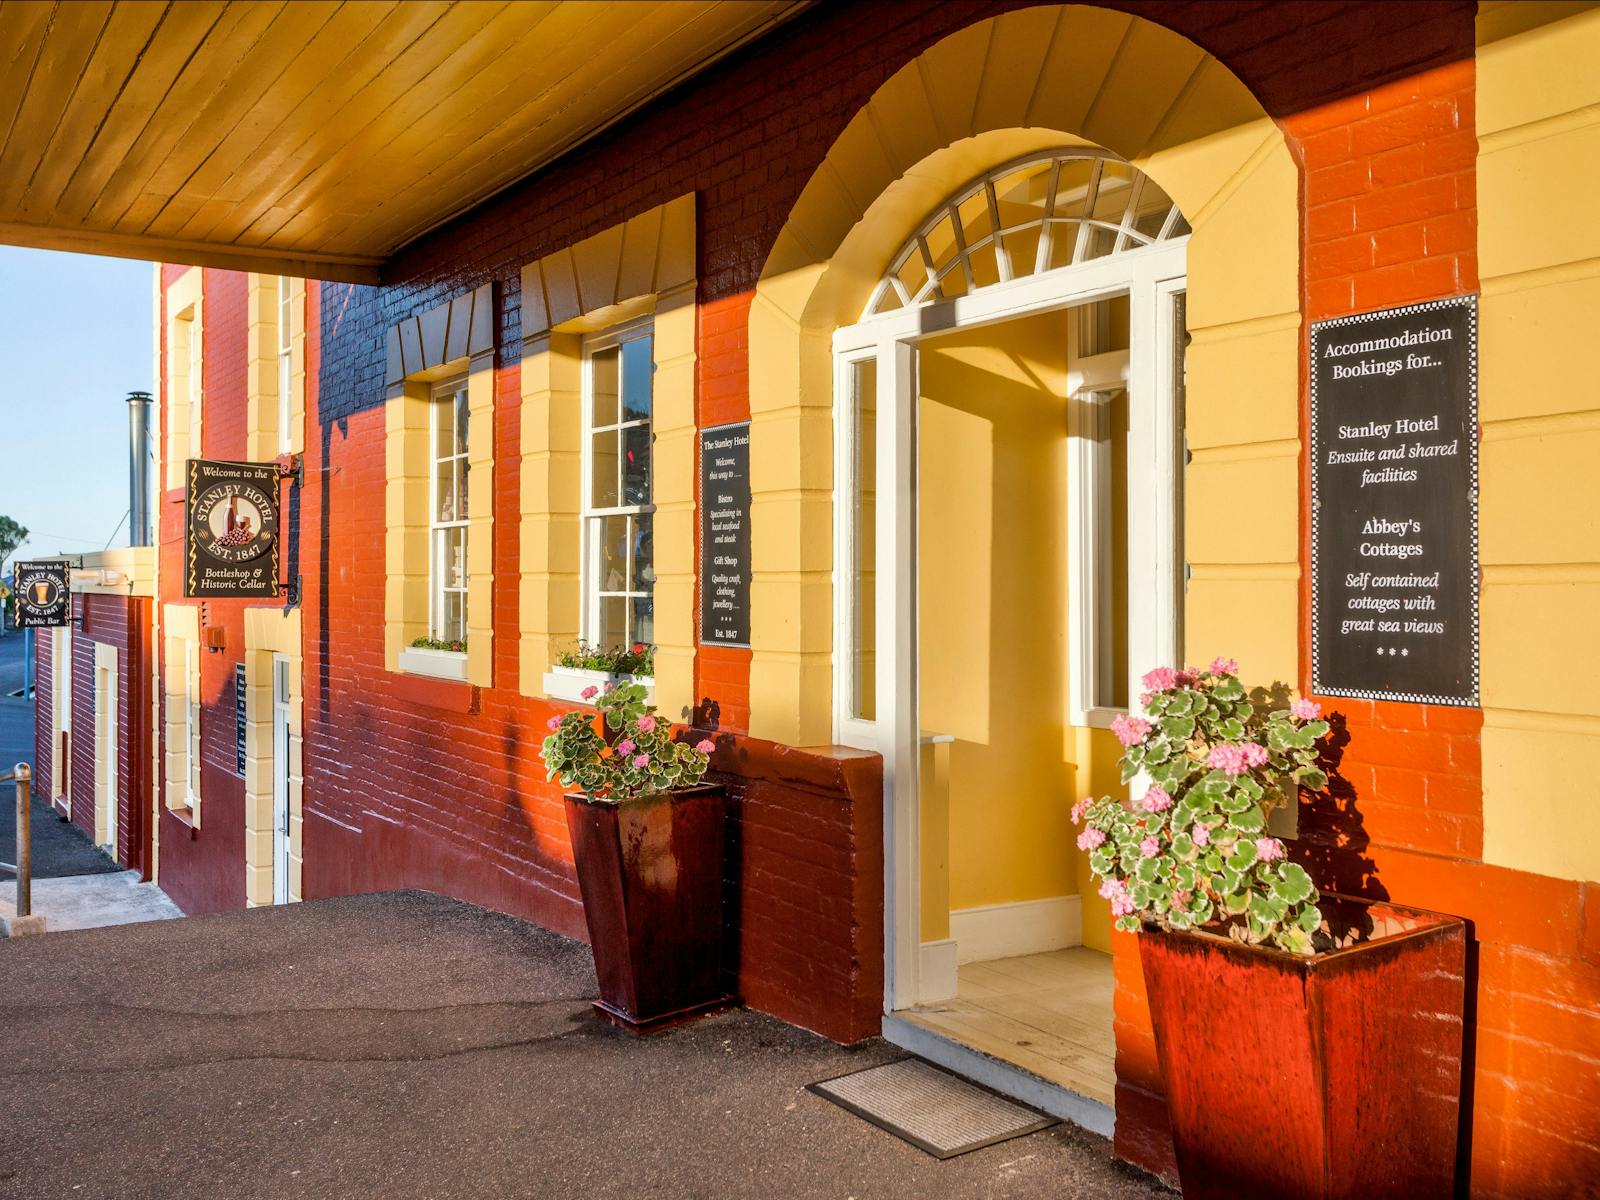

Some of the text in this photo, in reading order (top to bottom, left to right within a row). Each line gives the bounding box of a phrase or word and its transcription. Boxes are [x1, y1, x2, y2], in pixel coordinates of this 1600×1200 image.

[1324, 327, 1453, 358] Accommodation
[1332, 353, 1442, 380] Bookings for...
[1338, 415, 1439, 439] Stanley Hotel
[704, 434, 749, 450] The Stanley Hotel
[1327, 439, 1458, 465] Ensuite and shared
[202, 466, 268, 478] Welcome to the
[1360, 467, 1418, 488] facilities
[197, 484, 273, 524] STANLEY HOTEL
[718, 494, 733, 504] Bistro
[723, 521, 740, 532] seafood
[1361, 517, 1421, 537] Abbey's
[715, 534, 736, 543] and steak
[208, 541, 261, 560] EST. 1847
[1359, 542, 1424, 560] Cottages
[714, 555, 738, 567] Gift Shop
[205, 567, 263, 580] Bottleshop &
[712, 574, 728, 585] Quality
[1345, 572, 1440, 590] Self contained
[20, 572, 65, 594] STANLEY HOTEL
[200, 579, 267, 589] Historic Cellar
[26, 605, 58, 615] EST. 1847
[1347, 595, 1436, 614] cottages with
[25, 617, 60, 625] Public Bar
[1341, 618, 1445, 634] great sea views
[715, 628, 738, 639] Est. 1847
